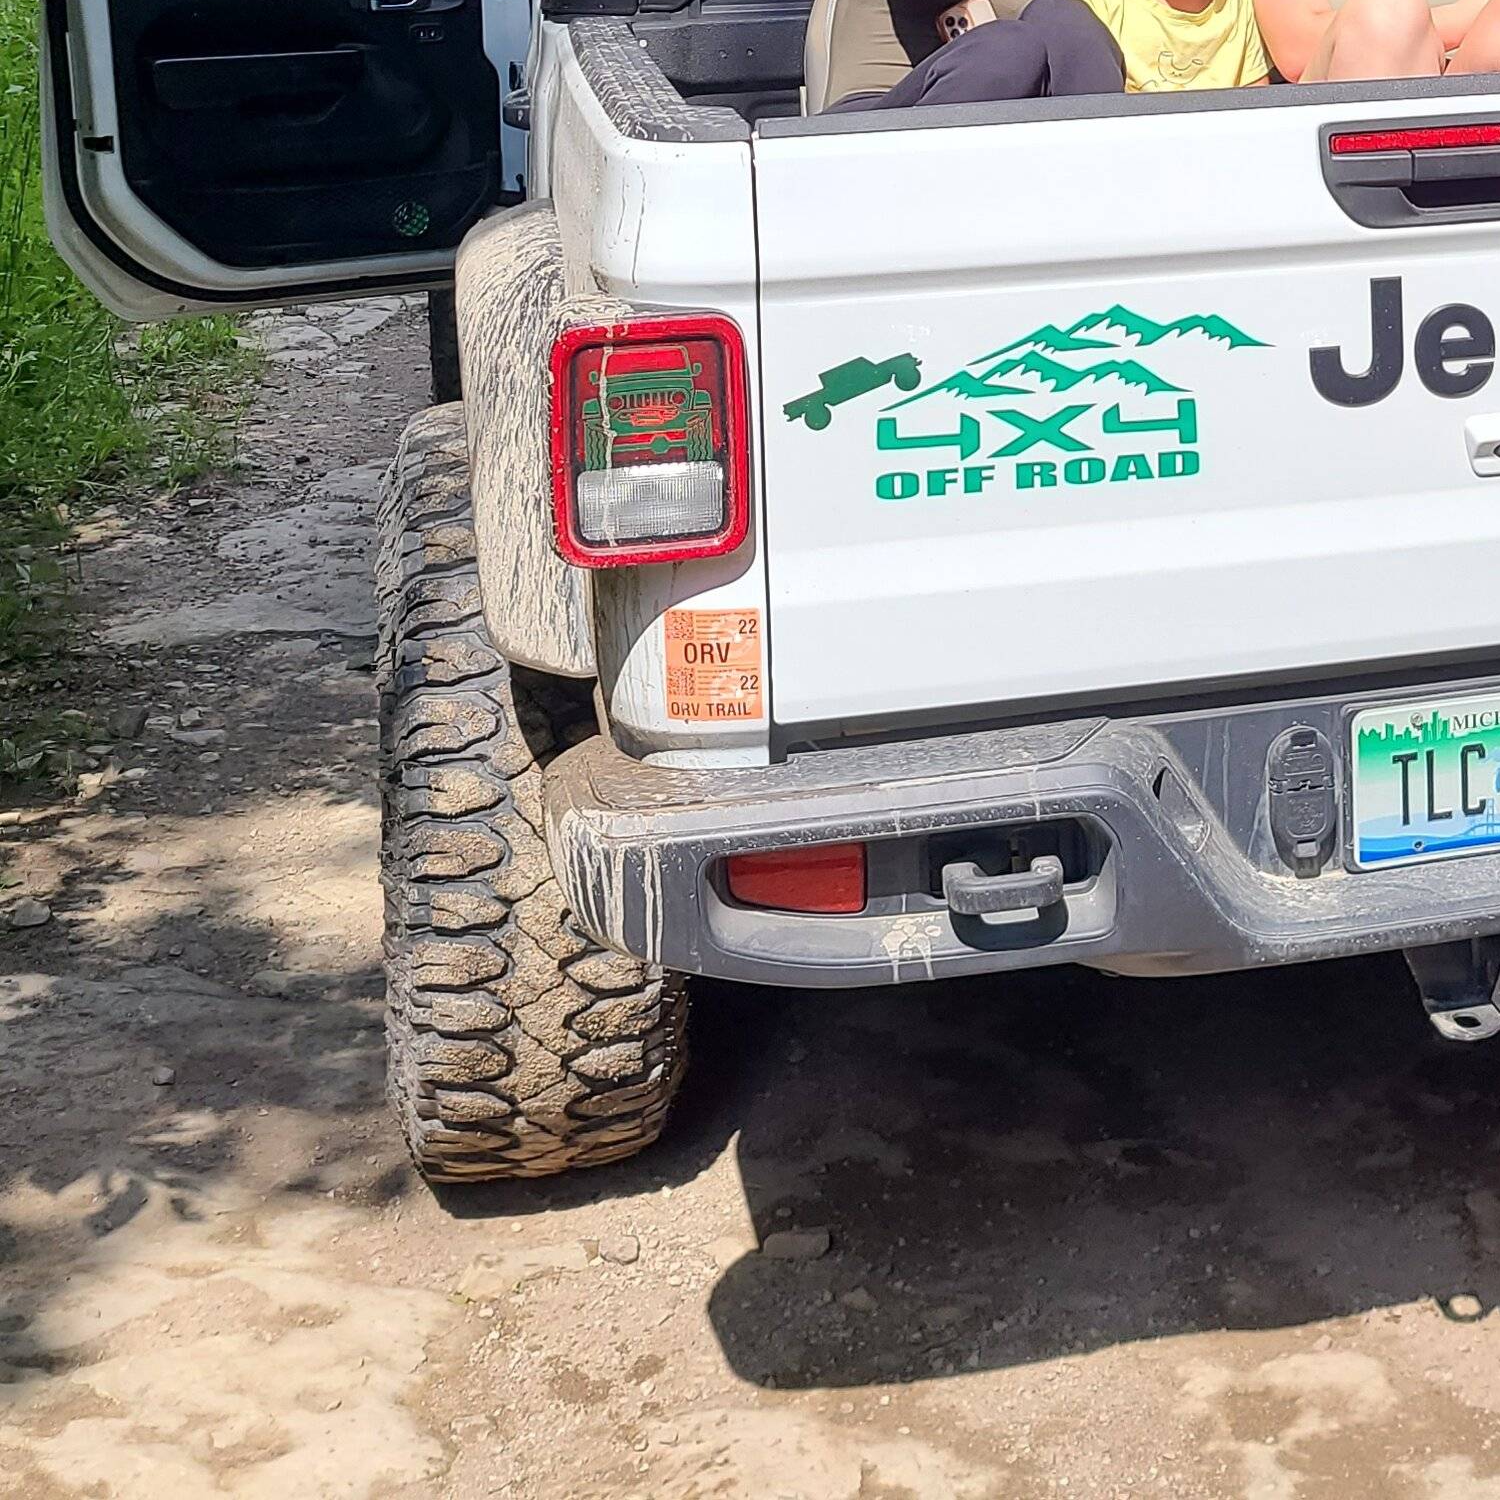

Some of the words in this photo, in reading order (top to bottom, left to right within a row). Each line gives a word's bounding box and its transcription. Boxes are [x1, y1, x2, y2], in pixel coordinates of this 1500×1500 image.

[876, 398, 1199, 461] 4X4
[875, 464, 996, 500] OFF
[1015, 450, 1201, 490] ROAD
[738, 618, 758, 635] 22
[683, 642, 731, 664] ORV
[739, 674, 759, 690] 22
[671, 701, 700, 717] ORV
[705, 702, 752, 717] TRAIL
[1392, 741, 1487, 827] TLC
